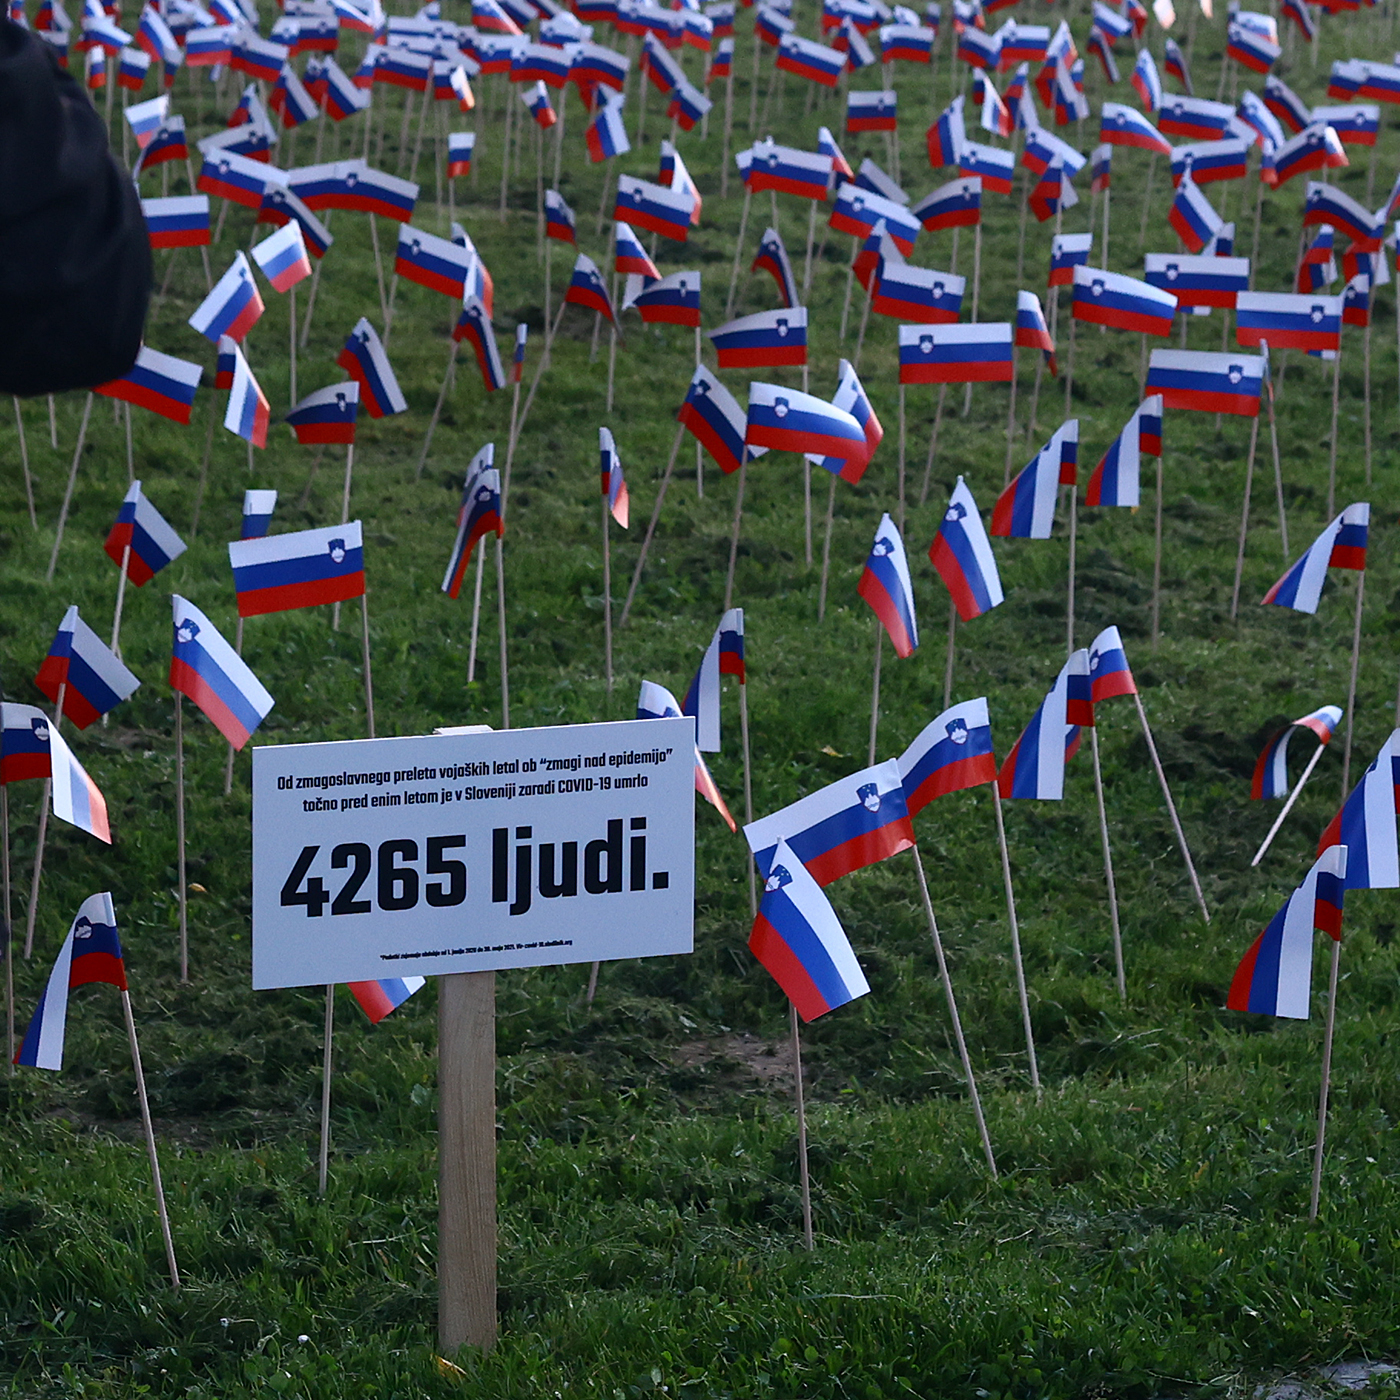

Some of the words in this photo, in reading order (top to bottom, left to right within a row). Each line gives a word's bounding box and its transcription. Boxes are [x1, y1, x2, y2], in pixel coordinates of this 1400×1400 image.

[277, 775, 293, 790] Od
[296, 772, 390, 789] zmagoslavnega
[394, 767, 436, 784] preleta
[439, 761, 490, 780] vojaških
[493, 759, 519, 775] letal
[522, 758, 536, 772] ob
[540, 755, 581, 771] “zmagi
[584, 753, 605, 768] nad
[609, 749, 673, 768] epidemijo”
[303, 797, 338, 812] točno
[341, 794, 368, 812] pred
[371, 792, 400, 807] enim
[404, 791, 438, 805] letom
[441, 788, 452, 804] je
[455, 789, 462, 801] v
[465, 783, 516, 800] Sloveniji
[519, 780, 555, 796] zaradi
[558, 776, 611, 793] COVID-19
[614, 774, 648, 789] umrlo
[280, 834, 467, 918] 4265
[492, 817, 669, 916] ljudi.
